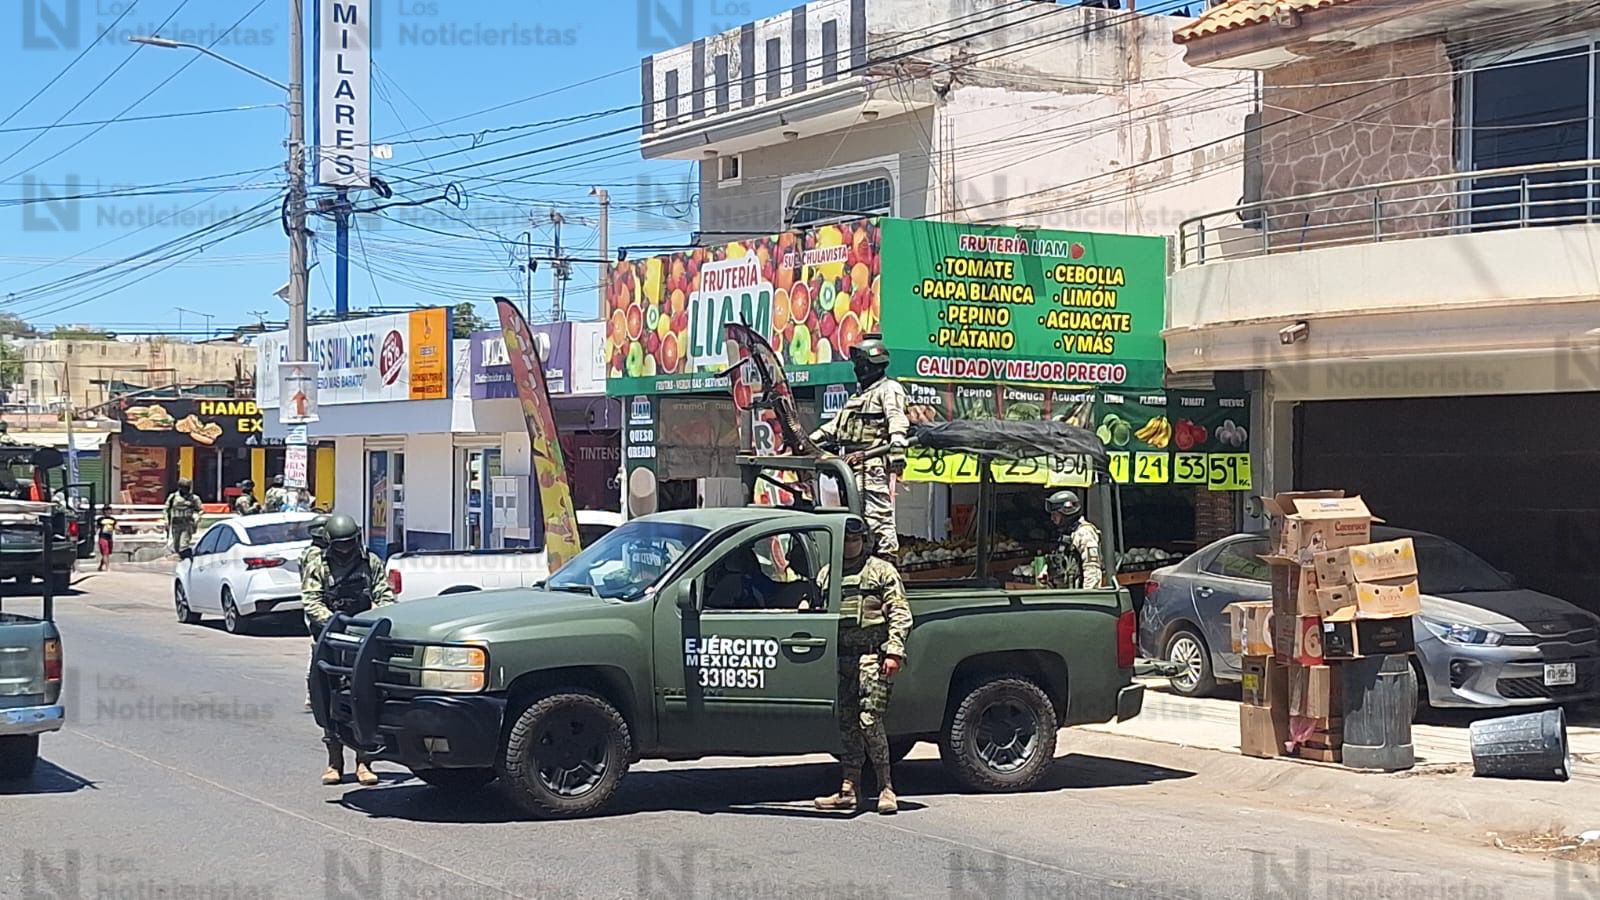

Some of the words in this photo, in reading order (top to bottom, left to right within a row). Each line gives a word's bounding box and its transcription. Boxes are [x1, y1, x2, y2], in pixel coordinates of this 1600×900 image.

[960, 233, 1029, 256] FRUTERÍA
[1032, 241, 1068, 258] LIAM
[703, 257, 758, 293] FRUTERÍA
[944, 257, 1014, 279] TOMATE
[1054, 265, 1125, 286] CEBOLLA
[922, 279, 967, 301] PAPA
[969, 282, 1034, 304] BLANCA
[1061, 286, 1117, 308] LIMÓN
[690, 290, 770, 358] LIAM
[947, 304, 1011, 326] PEPINO
[1046, 311, 1131, 331] AGUACATE
[938, 325, 1015, 350] PLÁTANO
[1063, 334, 1077, 353] Y
[1077, 330, 1114, 354] MÁS
[327, 333, 375, 371] SIMILARES
[916, 356, 988, 378] CALIDAD
[990, 358, 1006, 378] Y
[1007, 360, 1064, 381] MEJOR
[1066, 363, 1126, 384] PRECIO
[956, 386, 992, 398] Pepino
[629, 429, 654, 443] QUESO
[1138, 455, 1163, 479] 24
[1178, 455, 1206, 479] 33
[1210, 456, 1238, 485] 59
[685, 635, 779, 656] EJÉRCITO
[686, 655, 777, 669] MEXICANO
[698, 668, 765, 689] 3318351
